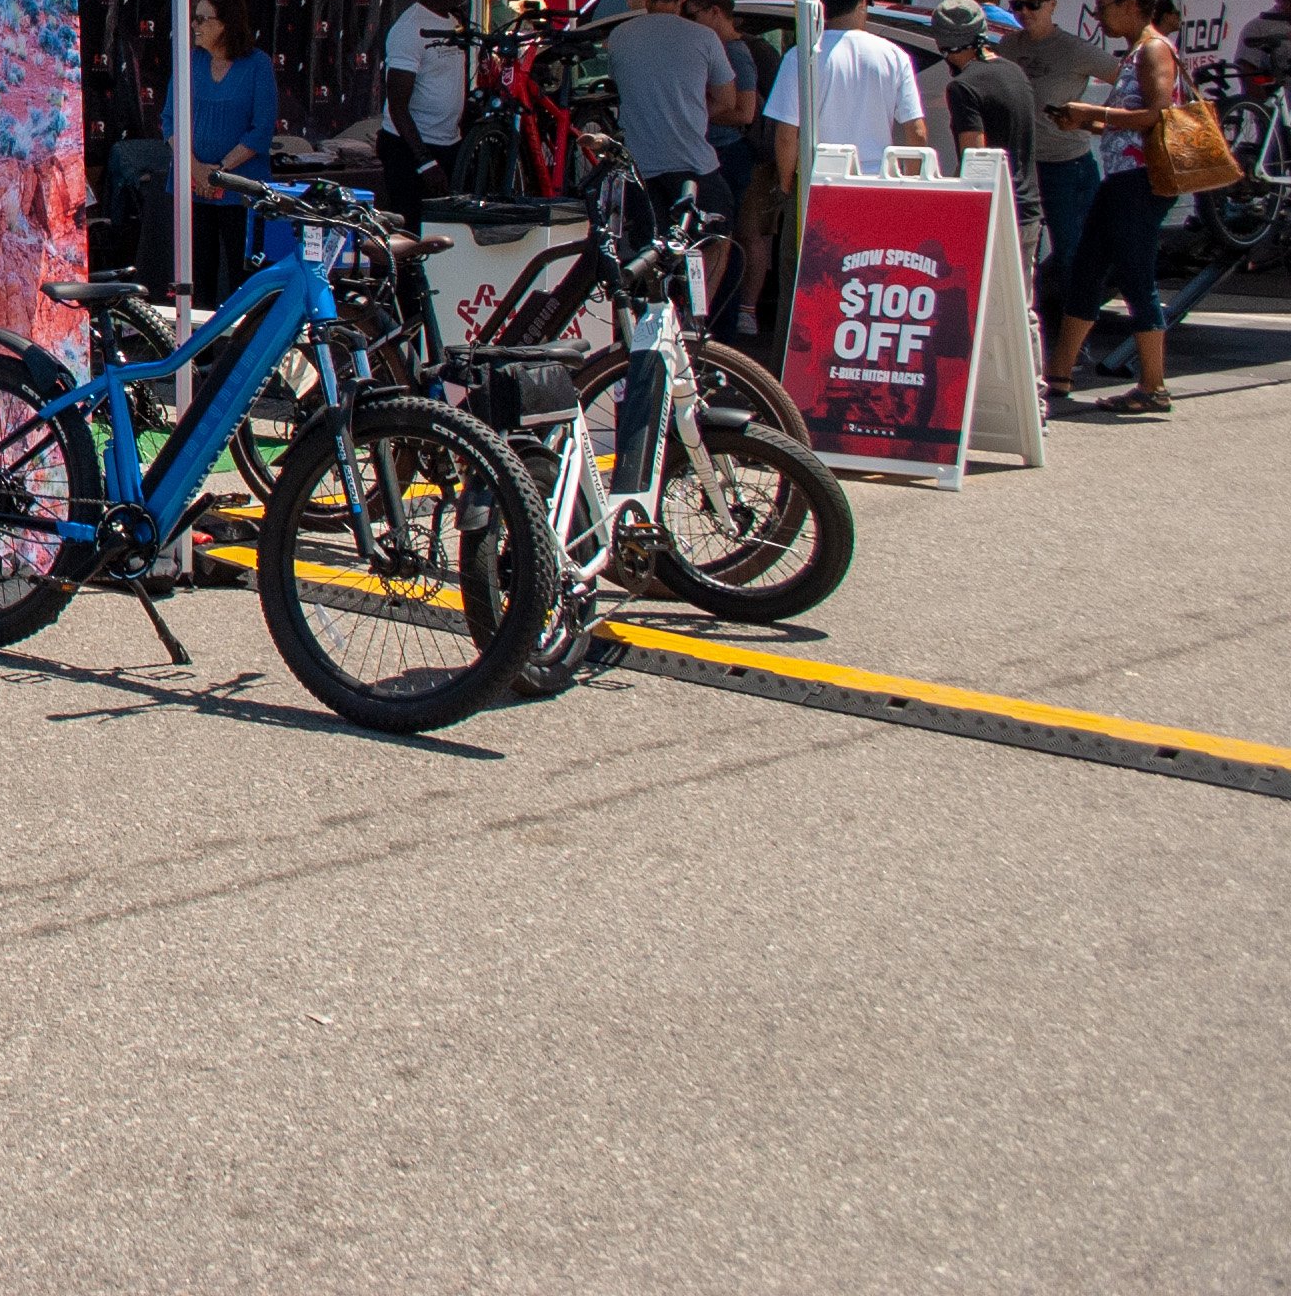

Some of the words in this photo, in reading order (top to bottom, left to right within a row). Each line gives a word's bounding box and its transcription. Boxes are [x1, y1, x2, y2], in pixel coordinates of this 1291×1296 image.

[842, 249, 884, 272] SHOW
[885, 249, 939, 278] SPECIAL
[839, 278, 936, 320] $100
[833, 320, 931, 363] OFF
[829, 366, 861, 380] E-BIKE
[862, 368, 890, 383] HITCH
[891, 370, 925, 386] RACKS
